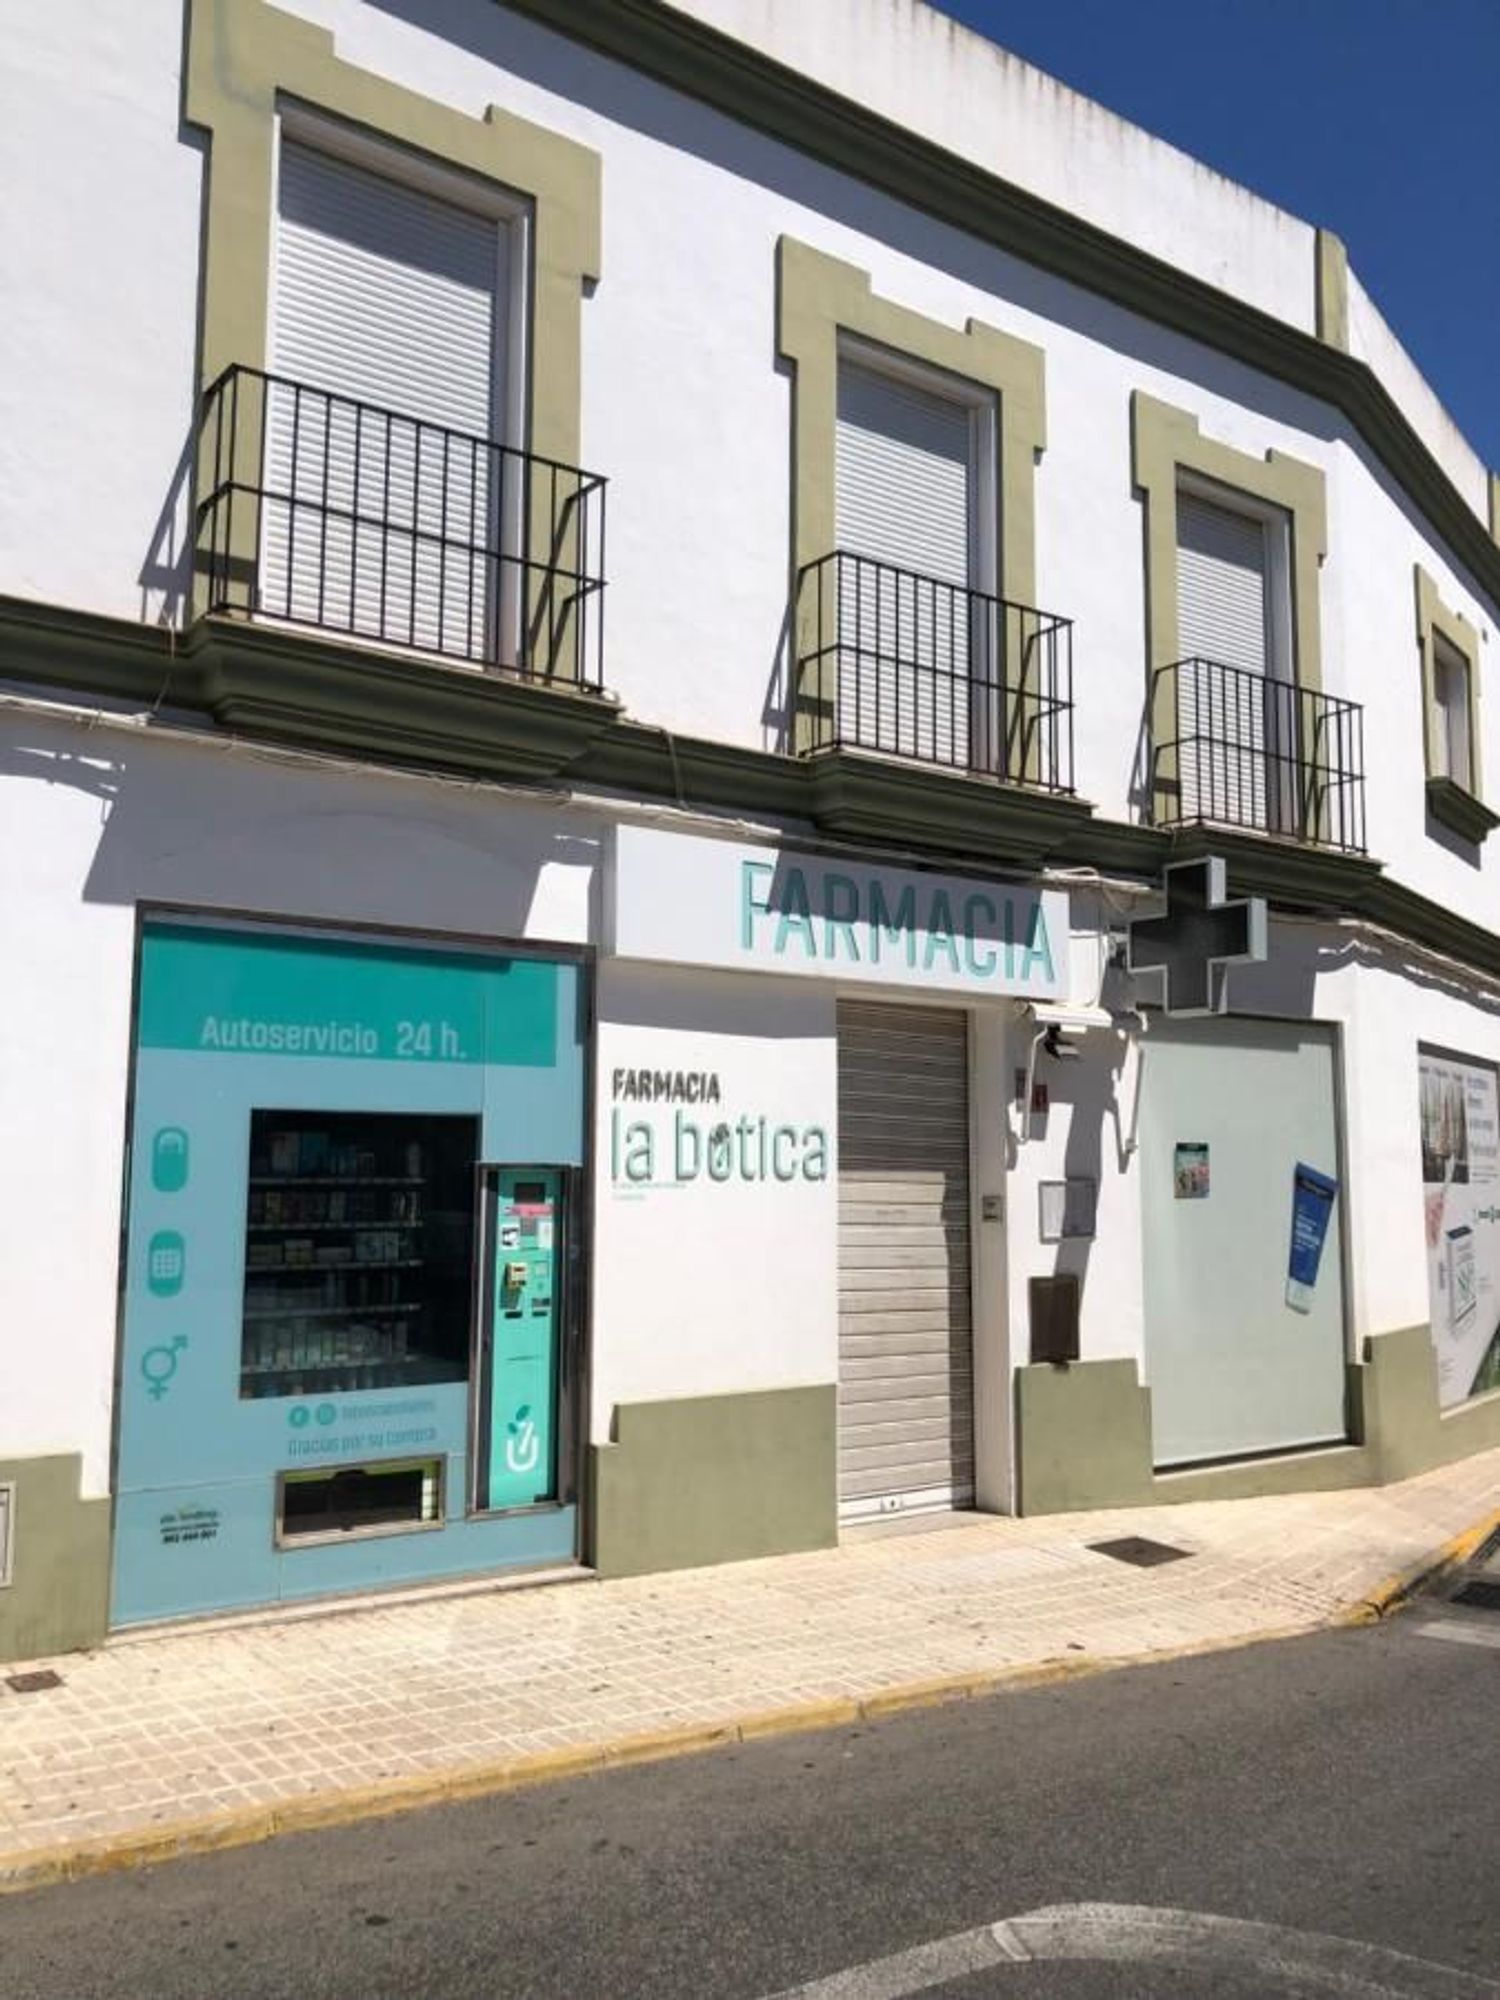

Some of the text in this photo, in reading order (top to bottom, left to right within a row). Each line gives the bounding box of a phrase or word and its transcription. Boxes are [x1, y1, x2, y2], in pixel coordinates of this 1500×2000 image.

[740, 860, 1055, 982] FARMACIA
[201, 1016, 467, 1059] Autoservicio 24 h.
[612, 1068, 721, 1104] FARMACIA
[611, 1108, 829, 1183] la botica
